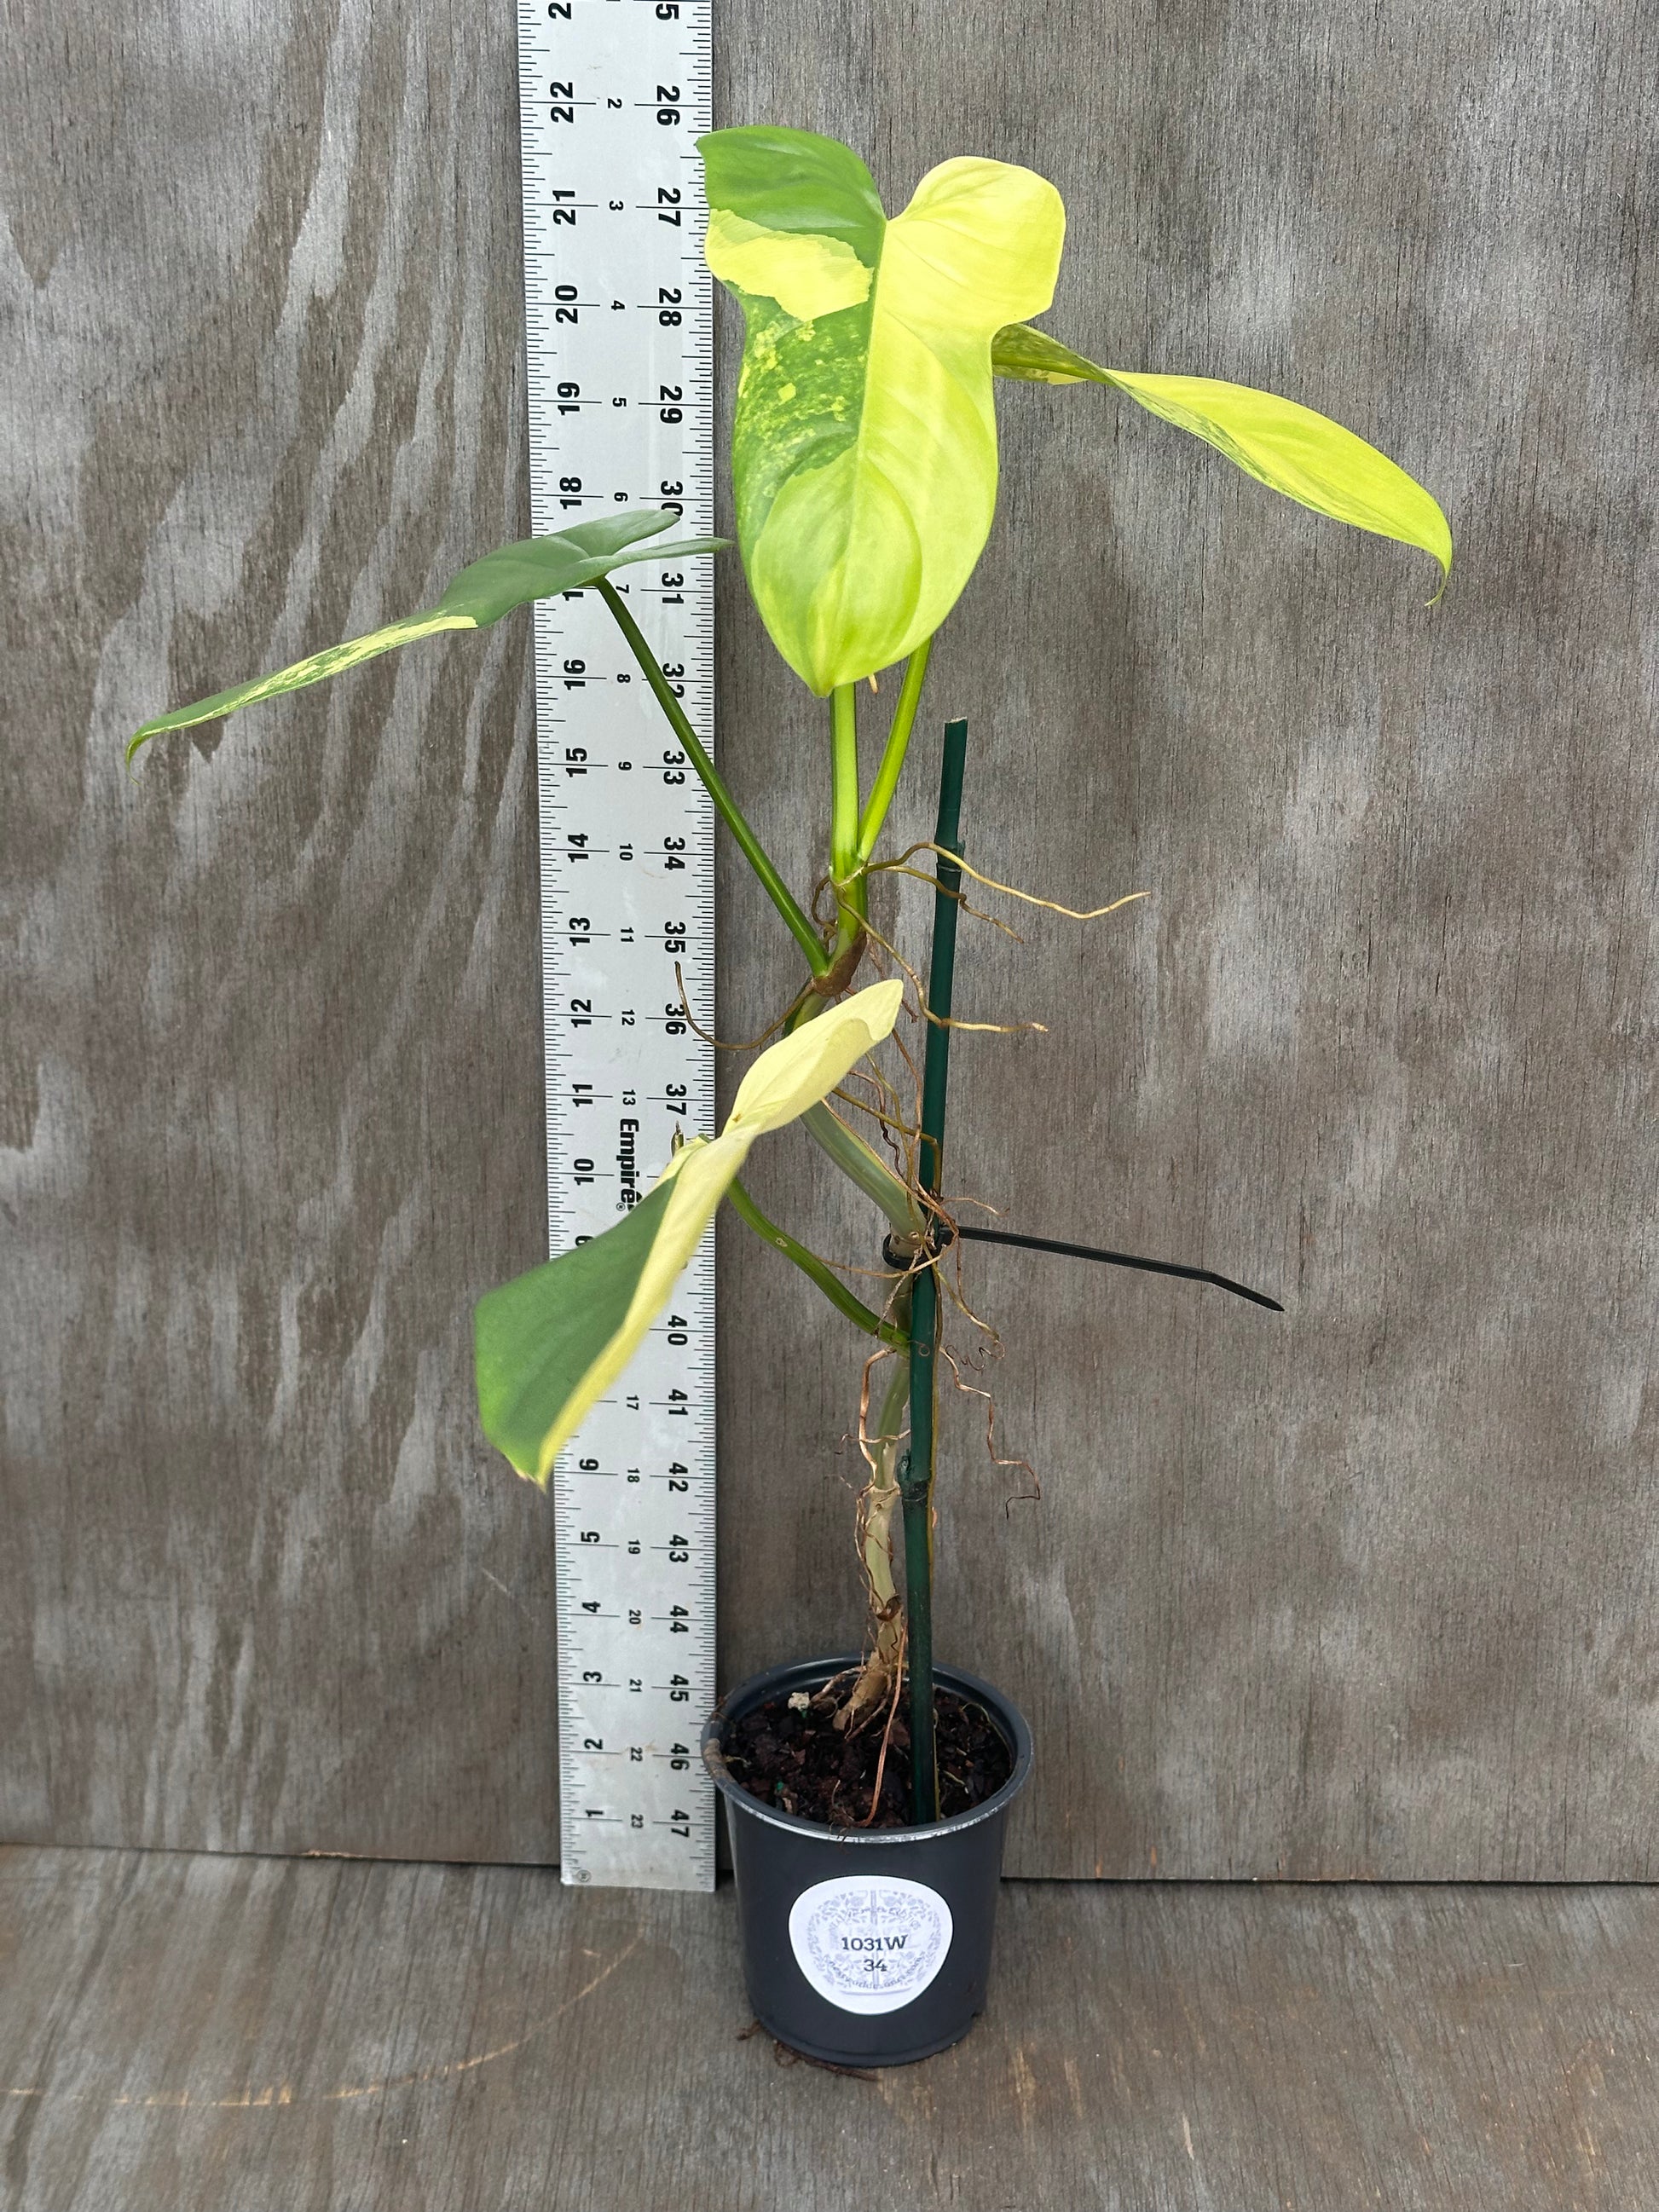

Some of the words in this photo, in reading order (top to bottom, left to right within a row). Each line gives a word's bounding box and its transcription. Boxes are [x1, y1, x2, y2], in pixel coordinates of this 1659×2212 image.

[548, 3, 572, 20] 2
[656, 3, 679, 20] 5
[550, 82, 573, 124] 22
[607, 98, 622, 109] 2
[656, 85, 680, 126] 26
[552, 189, 575, 225] 21
[609, 200, 624, 211] 3
[657, 187, 681, 227] 27
[555, 286, 577, 324] 20
[610, 300, 626, 311] 4
[658, 287, 682, 326] 28
[558, 383, 580, 416] 19
[612, 397, 627, 407] 5
[660, 384, 683, 424] 29
[559, 477, 582, 510] 18
[614, 492, 628, 502] 6
[562, 591, 584, 602] 1
[616, 584, 630, 594] 7
[661, 572, 685, 604] 31
[564, 660, 586, 690] 16
[616, 673, 631, 684] 8
[566, 748, 587, 777] 15
[618, 761, 633, 771] 9
[663, 750, 685, 785] 33
[568, 834, 589, 863] 14
[619, 843, 633, 861] 10
[664, 836, 686, 871] 34
[569, 917, 591, 947] 13
[621, 927, 634, 943] 11
[665, 921, 686, 954] 35
[571, 998, 592, 1028] 12
[621, 1009, 635, 1026] 12
[665, 1003, 687, 1036] 36
[572, 1083, 593, 1107] 11
[622, 1090, 636, 1106] 13
[666, 1083, 687, 1116] 37
[574, 1158, 594, 1186] 10
[668, 1314, 688, 1346] 40
[627, 1395, 639, 1411] 17
[668, 1389, 689, 1417] 41
[580, 1458, 599, 1471] 6
[627, 1467, 640, 1483] 18
[669, 1462, 689, 1493] 42
[581, 1531, 600, 1543] 5
[628, 1539, 641, 1555] 19
[669, 1534, 689, 1563] 43
[582, 1601, 601, 1613] 4
[628, 1609, 641, 1625] 20
[670, 1604, 689, 1634] 44
[583, 1671, 602, 1683] 3
[629, 1678, 642, 1694] 21
[670, 1674, 690, 1702] 45
[584, 1738, 604, 1750] 2
[630, 1747, 643, 1762] 22
[671, 1742, 690, 1771] 46
[585, 1809, 604, 1817] 1
[631, 1814, 644, 1828] 23
[671, 1809, 691, 1838] 47
[841, 1934, 909, 1951] 1031W
[864, 1959, 887, 1972] 34
